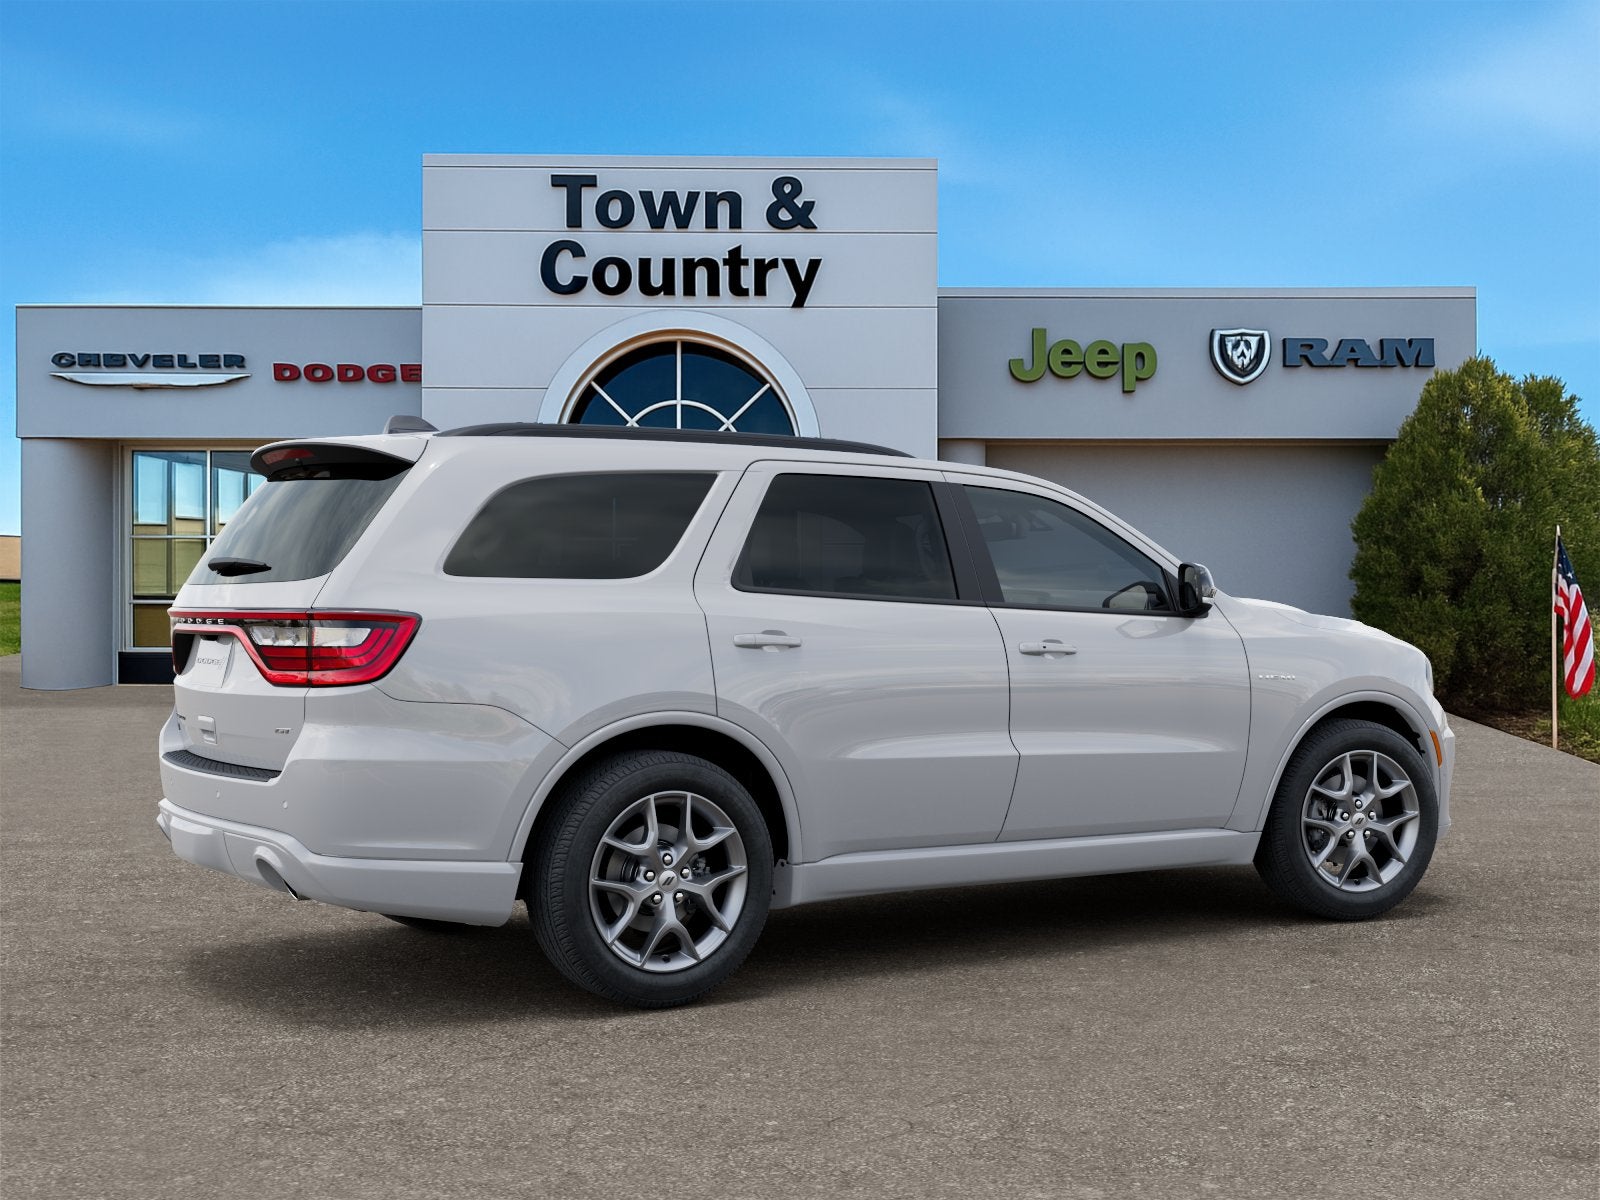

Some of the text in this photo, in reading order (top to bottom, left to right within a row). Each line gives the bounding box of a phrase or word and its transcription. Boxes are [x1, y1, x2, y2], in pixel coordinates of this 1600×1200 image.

[550, 174, 818, 230] Town &
[540, 239, 823, 308] Country
[273, 362, 422, 383] DODGE
[1009, 328, 1158, 393] Jeep
[1283, 337, 1436, 368] RAM
